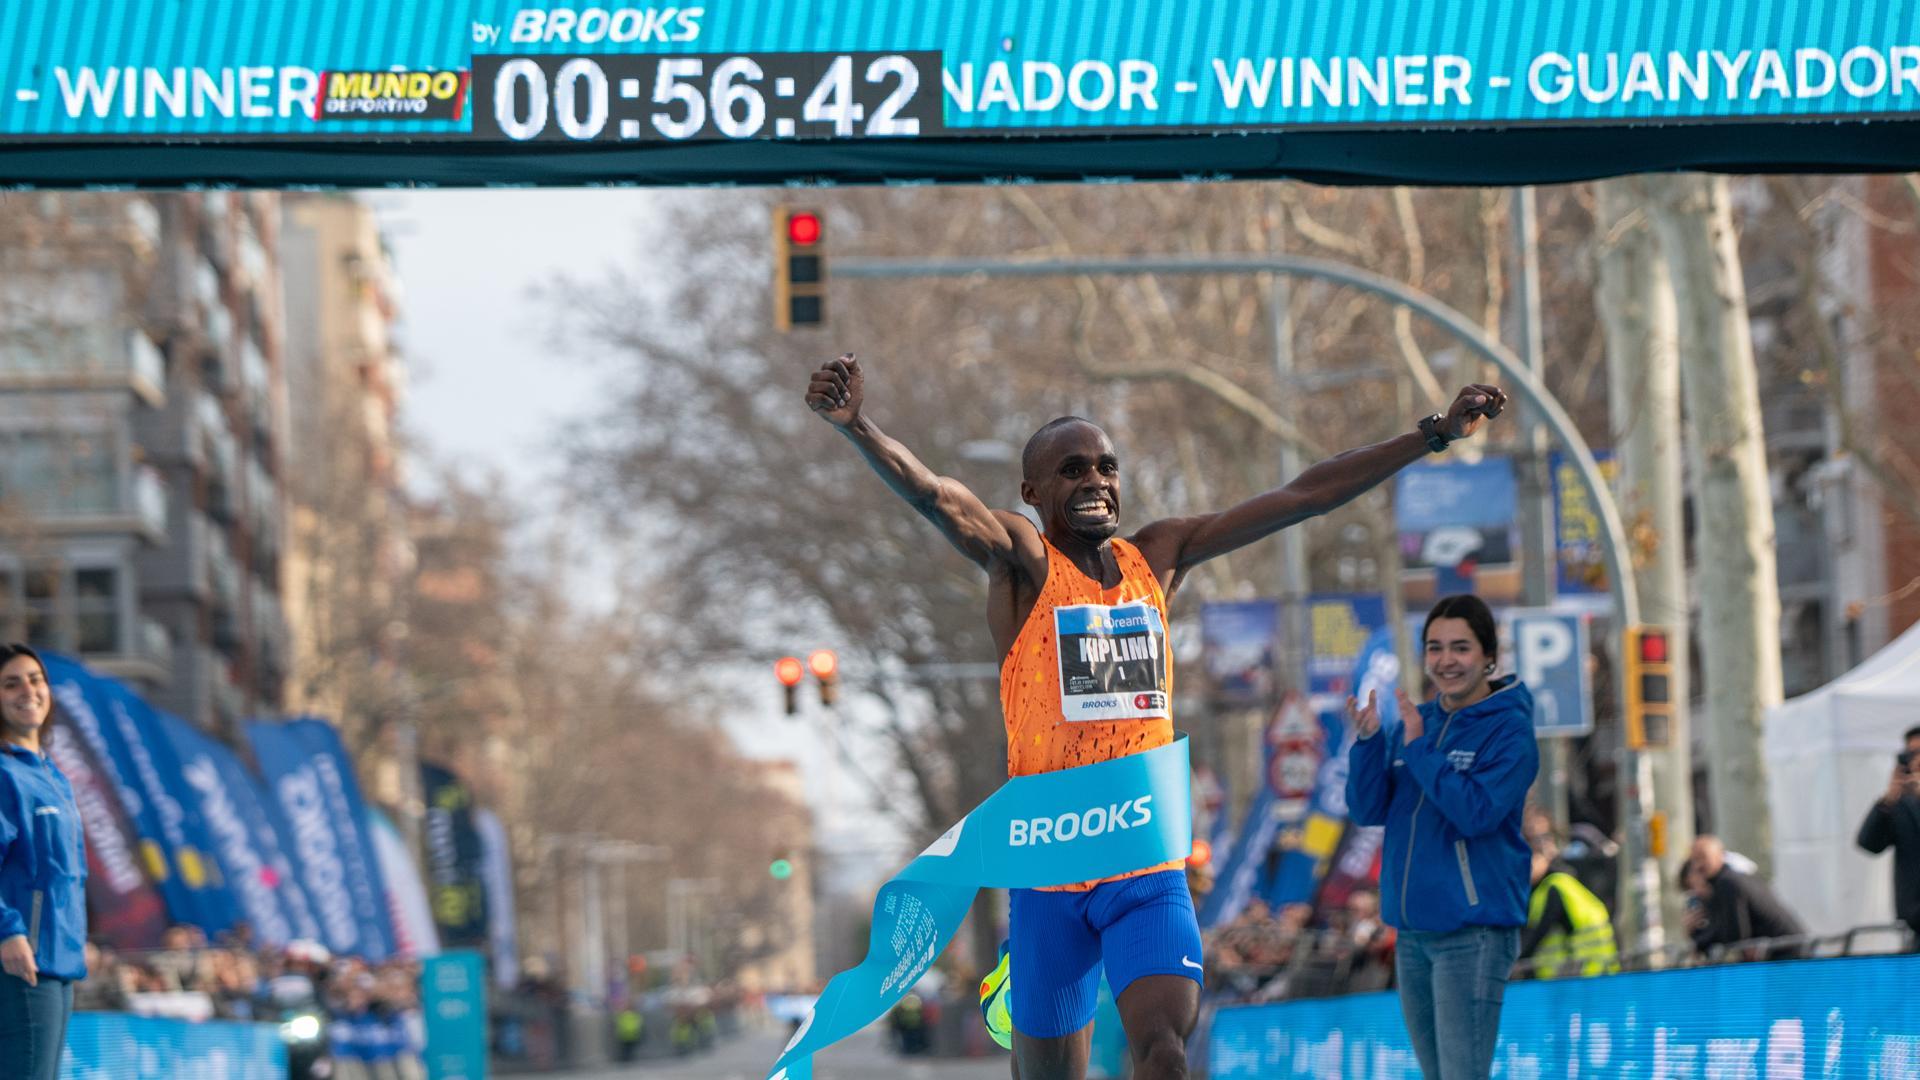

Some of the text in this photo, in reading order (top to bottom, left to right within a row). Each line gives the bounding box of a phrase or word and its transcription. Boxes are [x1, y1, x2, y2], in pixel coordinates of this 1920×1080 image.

[472, 7, 705, 47] by BROOKS
[54, 66, 318, 119] WINNER
[329, 71, 459, 100] MUNDO
[494, 55, 921, 141] 00:56:42
[943, 60, 1159, 113] NADOR
[1212, 55, 1473, 109] WINNER
[1528, 45, 1920, 104] GUANYADOR
[325, 97, 428, 113] DEPORTIVO
[1118, 665, 1126, 680] 1
[1521, 621, 1574, 690] P
[1081, 699, 1118, 710] BROOKS
[1009, 794, 1152, 847] BROOKS
